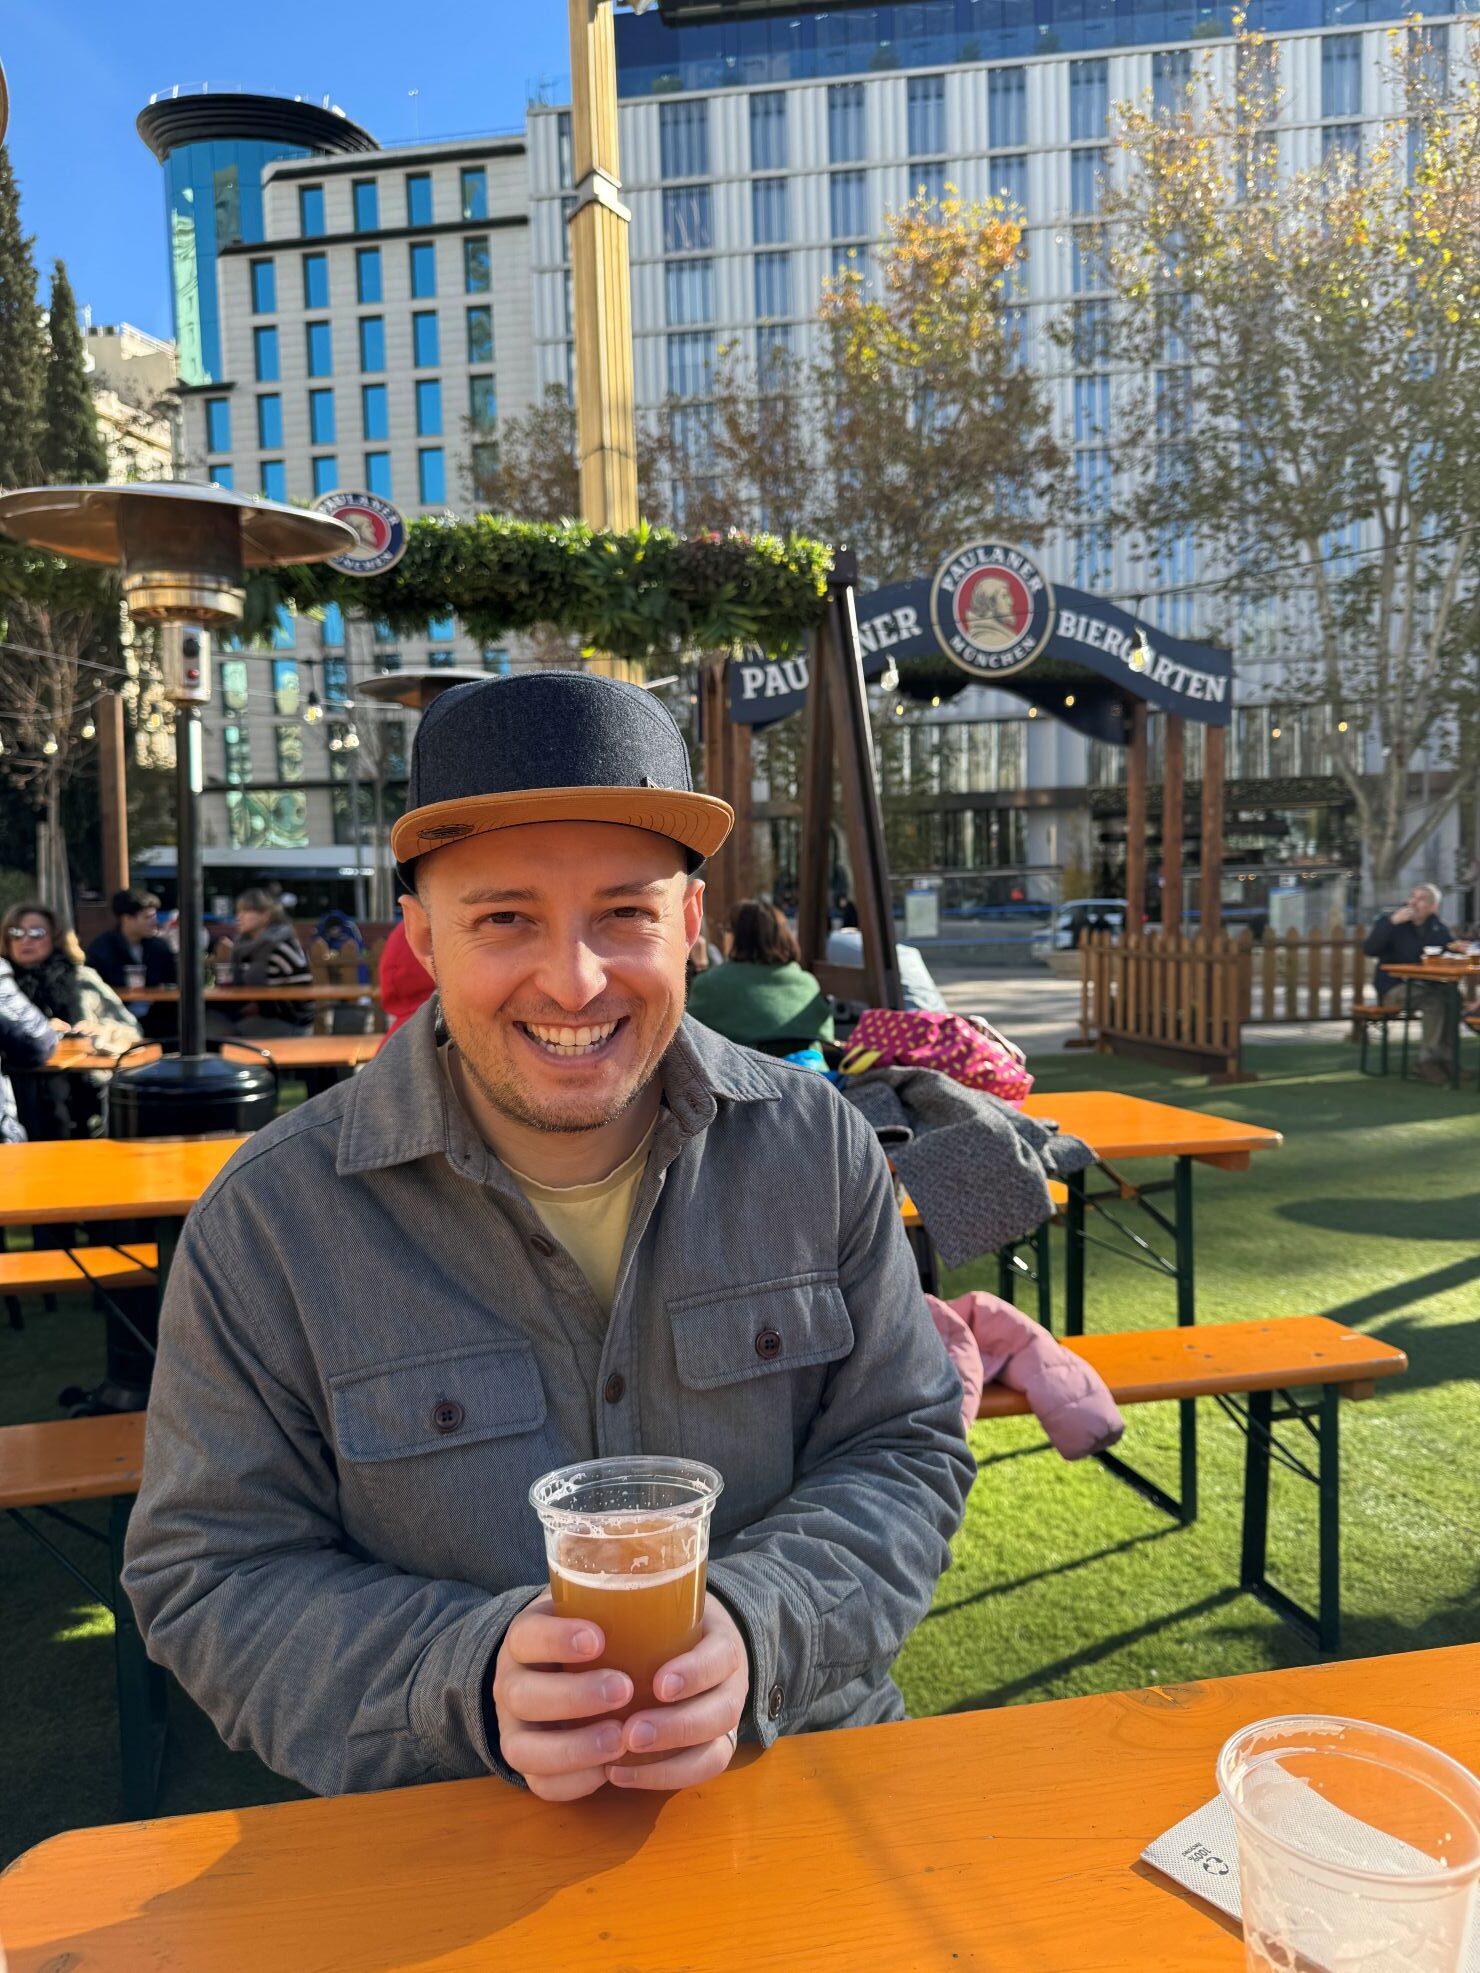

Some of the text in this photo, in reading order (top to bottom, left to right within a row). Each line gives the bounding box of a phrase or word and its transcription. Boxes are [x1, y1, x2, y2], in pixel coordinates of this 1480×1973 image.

[941, 547, 1043, 593] PAULANER
[740, 606, 923, 699] PAUNER
[1188, 1847, 1211, 1862] 100%
